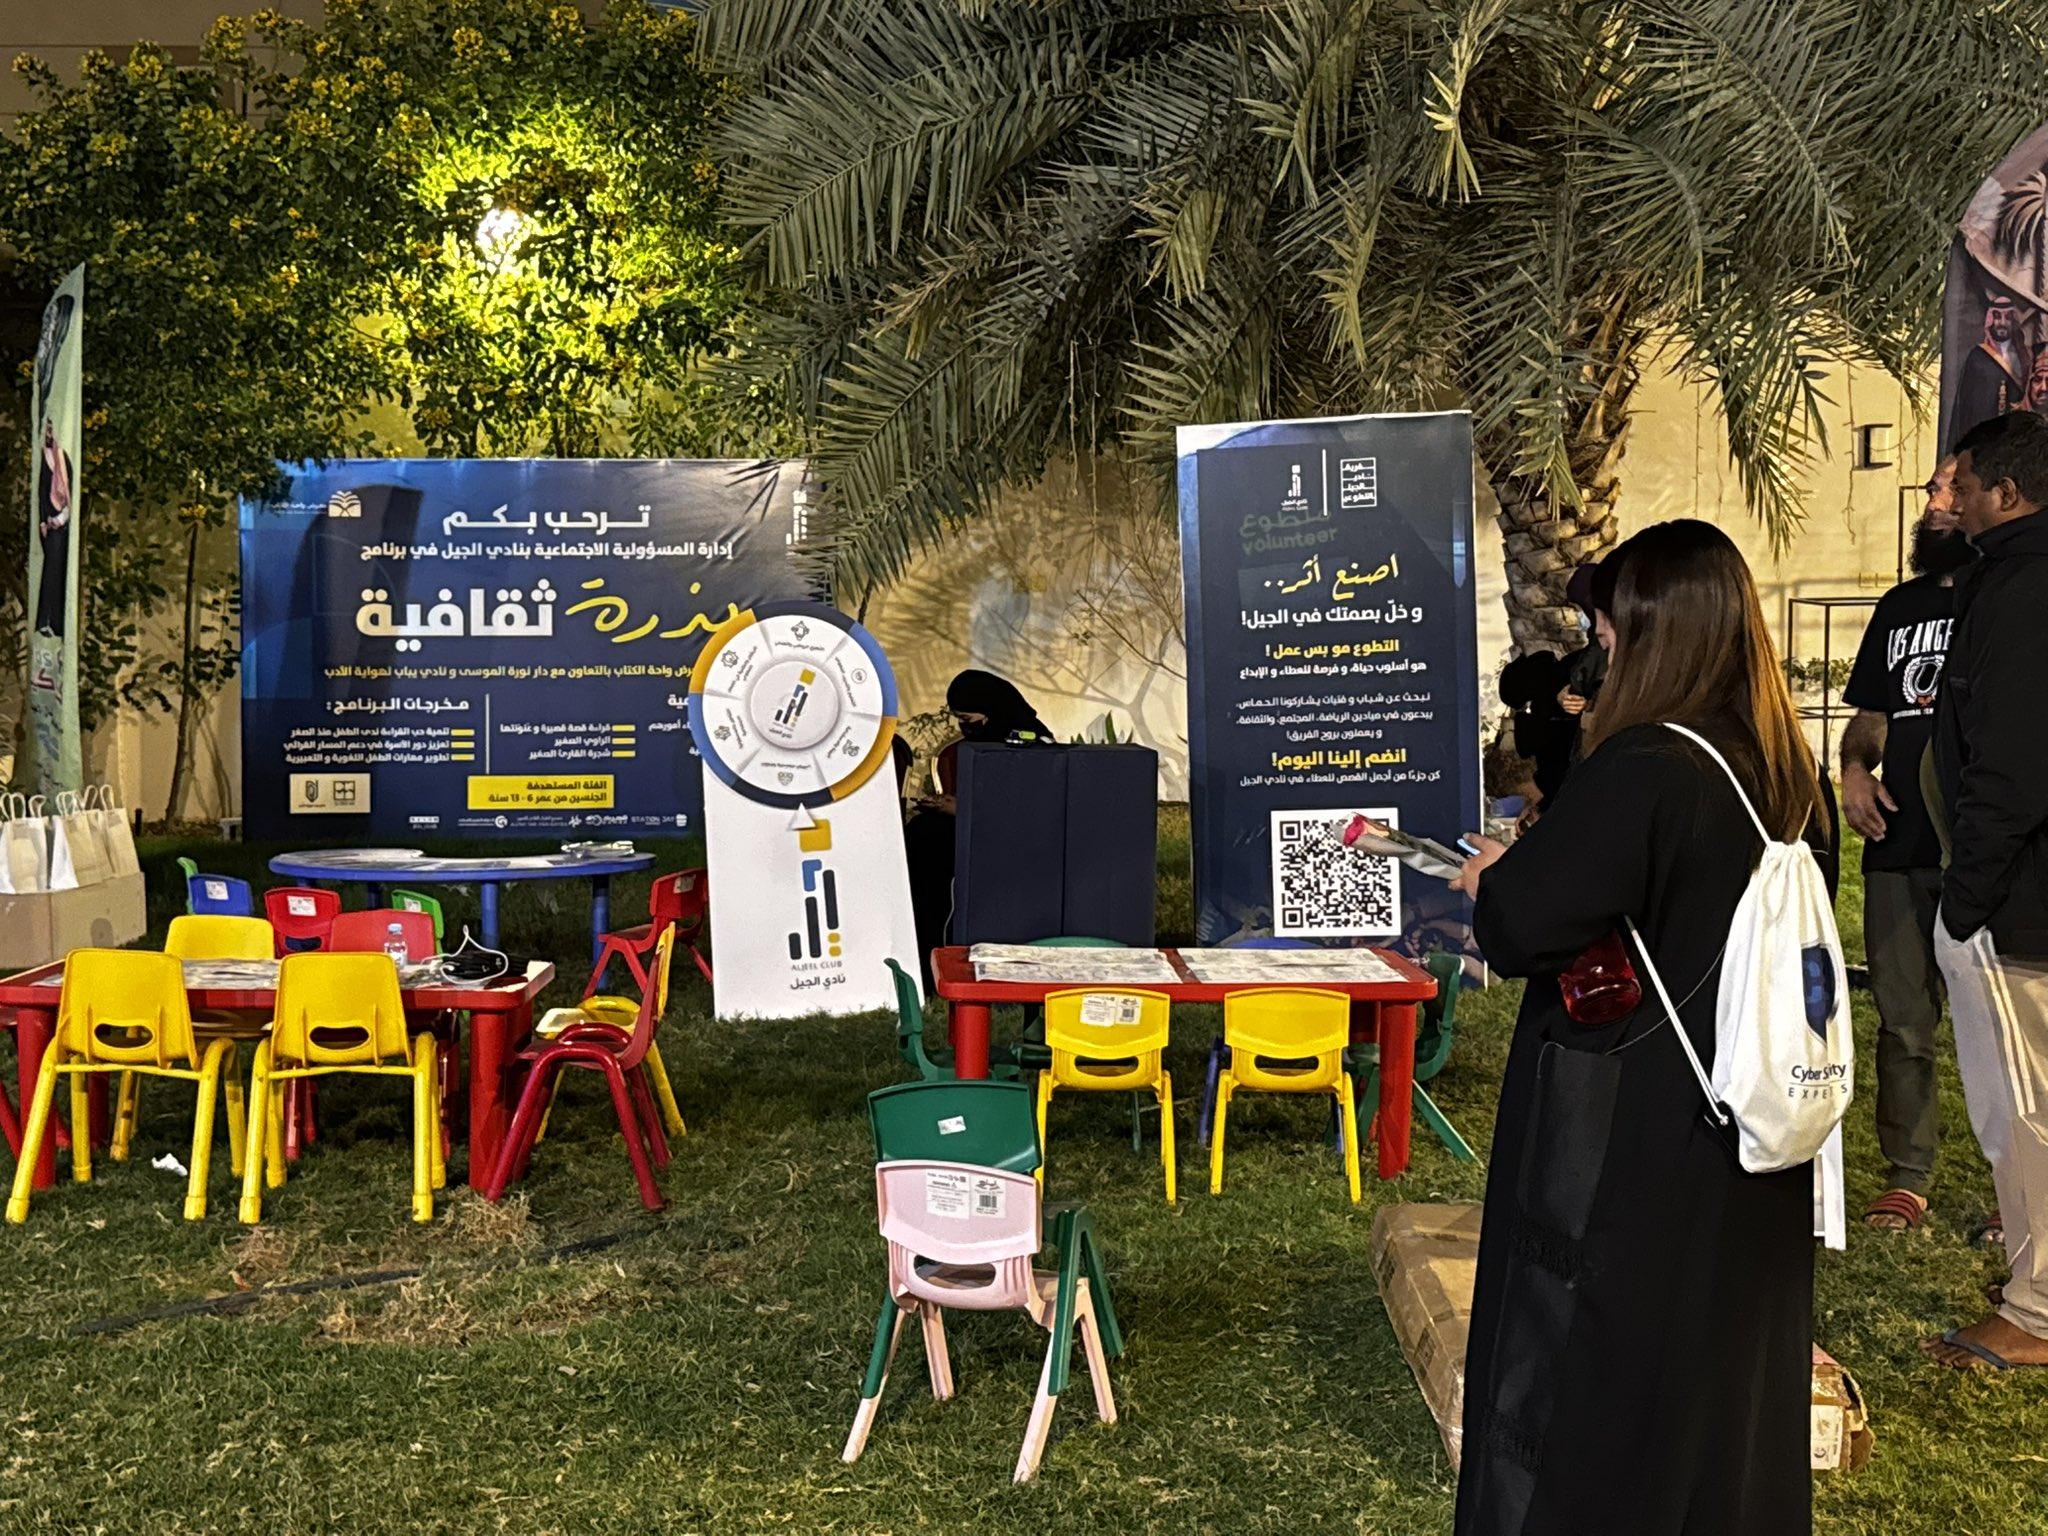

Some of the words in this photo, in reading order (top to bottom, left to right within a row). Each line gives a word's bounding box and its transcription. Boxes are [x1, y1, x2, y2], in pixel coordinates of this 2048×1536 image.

[442, 504, 537, 535] بكم
[544, 505, 651, 535] ترحب
[360, 542, 407, 561] برنامج
[409, 543, 438, 560] في
[441, 543, 482, 560] الجيل
[488, 542, 531, 560] بنادي
[535, 542, 609, 560] الاجتماعية
[613, 542, 694, 560] المسؤولية
[698, 542, 734, 560] إدارة
[1332, 553, 1399, 601] اصنع
[355, 578, 557, 652] ثقافية
[1241, 608, 1288, 629] الجيل!
[1292, 607, 1322, 627] في
[1325, 606, 1381, 624] بصمتك
[1411, 606, 1423, 623] و
[1331, 644, 1350, 658] مو
[1353, 639, 1400, 657] التطوع
[1887, 625, 1912, 672] LOS
[1908, 617, 1955, 656] ANGE
[1272, 644, 1301, 660] عمل
[1303, 645, 1329, 659] بس
[324, 665, 352, 677] الأدب
[354, 666, 392, 679] لهواية
[419, 666, 447, 679] نادي
[448, 668, 457, 679] و
[459, 666, 506, 679] الموسى
[508, 666, 531, 679] نورة
[533, 666, 548, 678] دار
[550, 666, 566, 678] مع
[567, 665, 611, 678] بالتعاون
[613, 665, 646, 678] الكتاب
[647, 665, 672, 678] واحة
[1239, 666, 1269, 680] الإبداع
[1270, 667, 1278, 678] و
[1279, 664, 1312, 676] للعطاء
[1313, 663, 1339, 676] فرصة
[1340, 664, 1348, 676] و
[1375, 659, 1409, 674] أسلوب
[1410, 660, 1427, 674] هو
[1348, 696, 1355, 706] و
[1356, 693, 1384, 704] شباب
[1385, 694, 1401, 704] عن
[1402, 692, 1431, 702] نبحث
[333, 698, 400, 714] البرنامج
[403, 698, 470, 713] مخرجات
[1382, 710, 1399, 720] في
[1375, 729, 1383, 739] و
[1271, 750, 1323, 771] اليوم!
[1327, 749, 1362, 769] إلينا
[1365, 748, 1407, 768] انضم
[1239, 775, 1263, 787] الجيل
[1264, 774, 1287, 786] نادي
[1287, 774, 1305, 785] في
[1393, 772, 1407, 782] من
[820, 960, 843, 970] CLUB
[789, 976, 821, 991] الجيل
[822, 972, 847, 991] نادي
